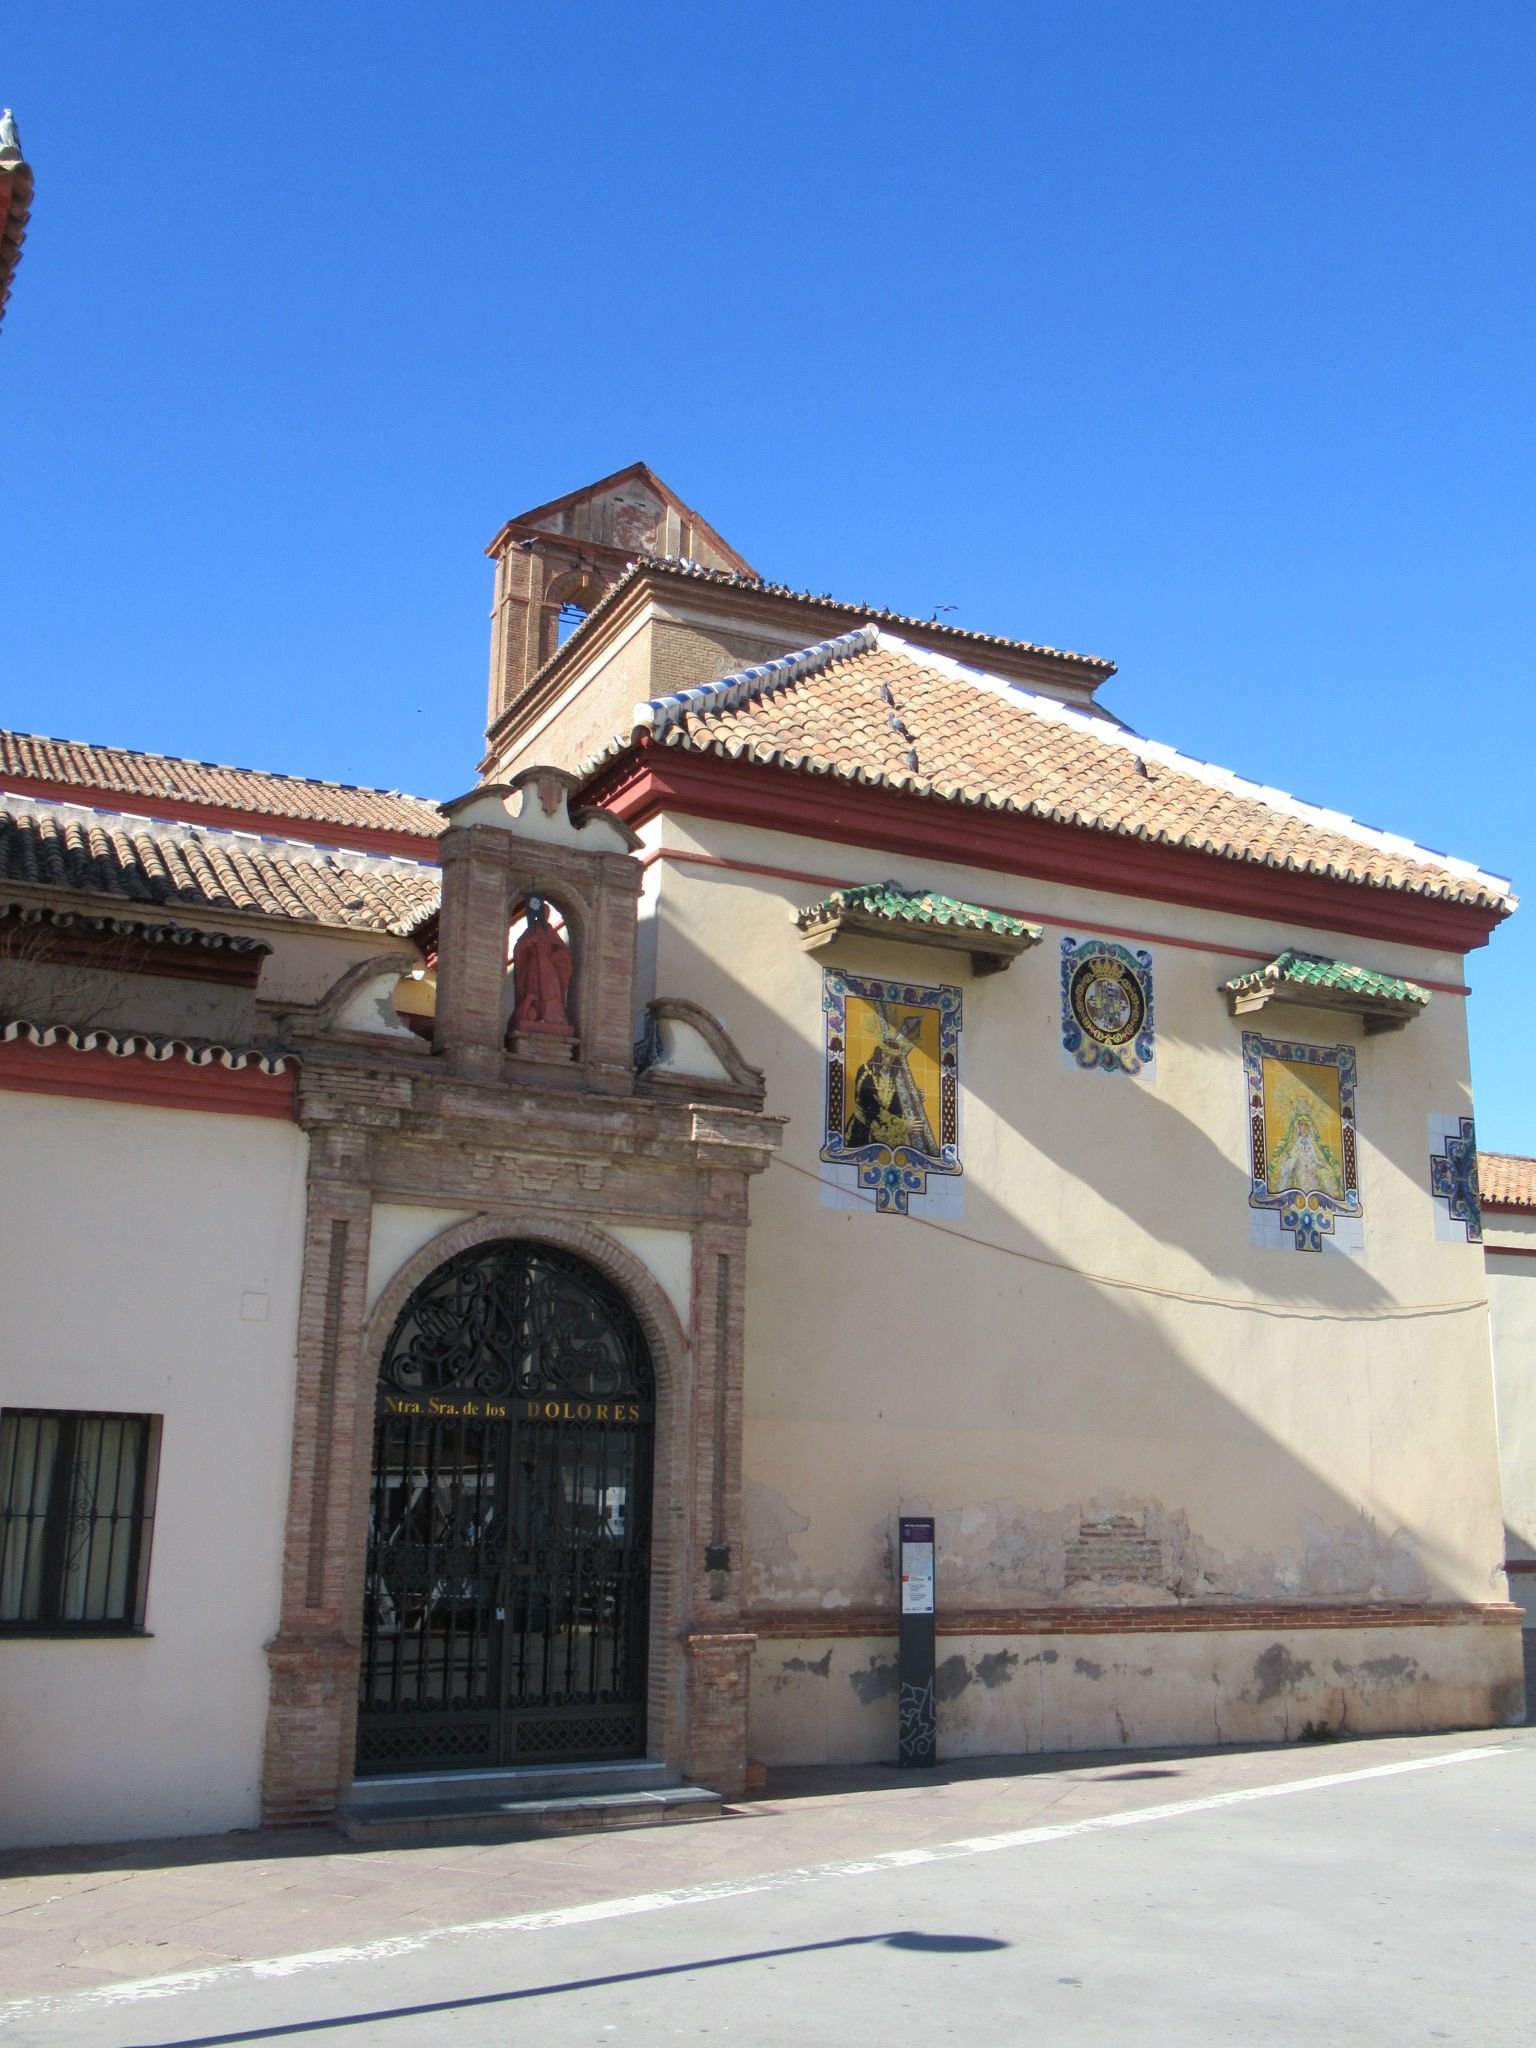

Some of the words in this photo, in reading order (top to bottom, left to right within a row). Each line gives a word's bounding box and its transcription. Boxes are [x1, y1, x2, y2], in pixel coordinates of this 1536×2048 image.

[428, 1396, 459, 1415] Sra.
[463, 1401, 479, 1416] de
[485, 1402, 506, 1417] los
[527, 1402, 640, 1420] DOLORES
